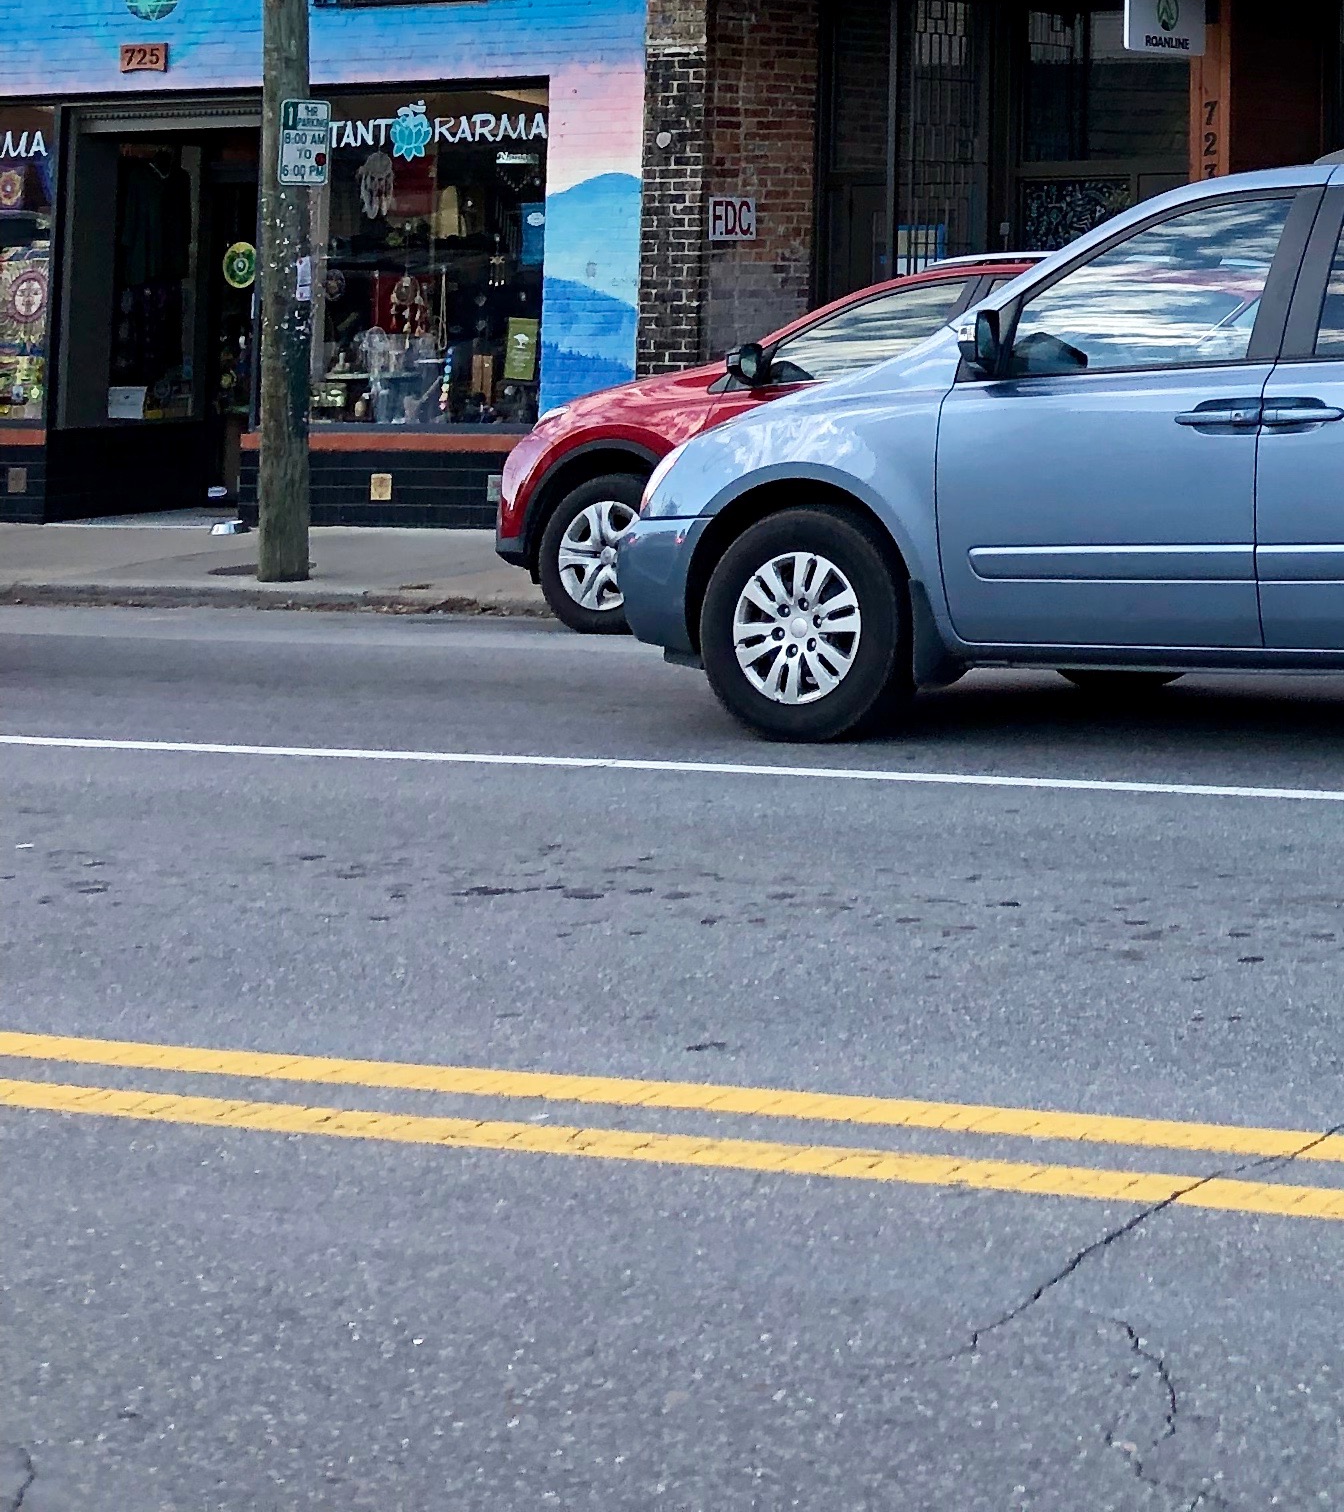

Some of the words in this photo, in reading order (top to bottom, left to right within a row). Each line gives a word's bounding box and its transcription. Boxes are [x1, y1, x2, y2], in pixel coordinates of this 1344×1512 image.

[1145, 34, 1190, 50] ROANLINE
[125, 47, 160, 66] 725
[297, 117, 327, 128] PARKING
[329, 117, 398, 148] TANT
[433, 112, 549, 144] KARMA
[310, 132, 326, 145] AM
[297, 148, 312, 160] TO
[309, 164, 324, 177] PM
[712, 200, 754, 236] F.D.C.
